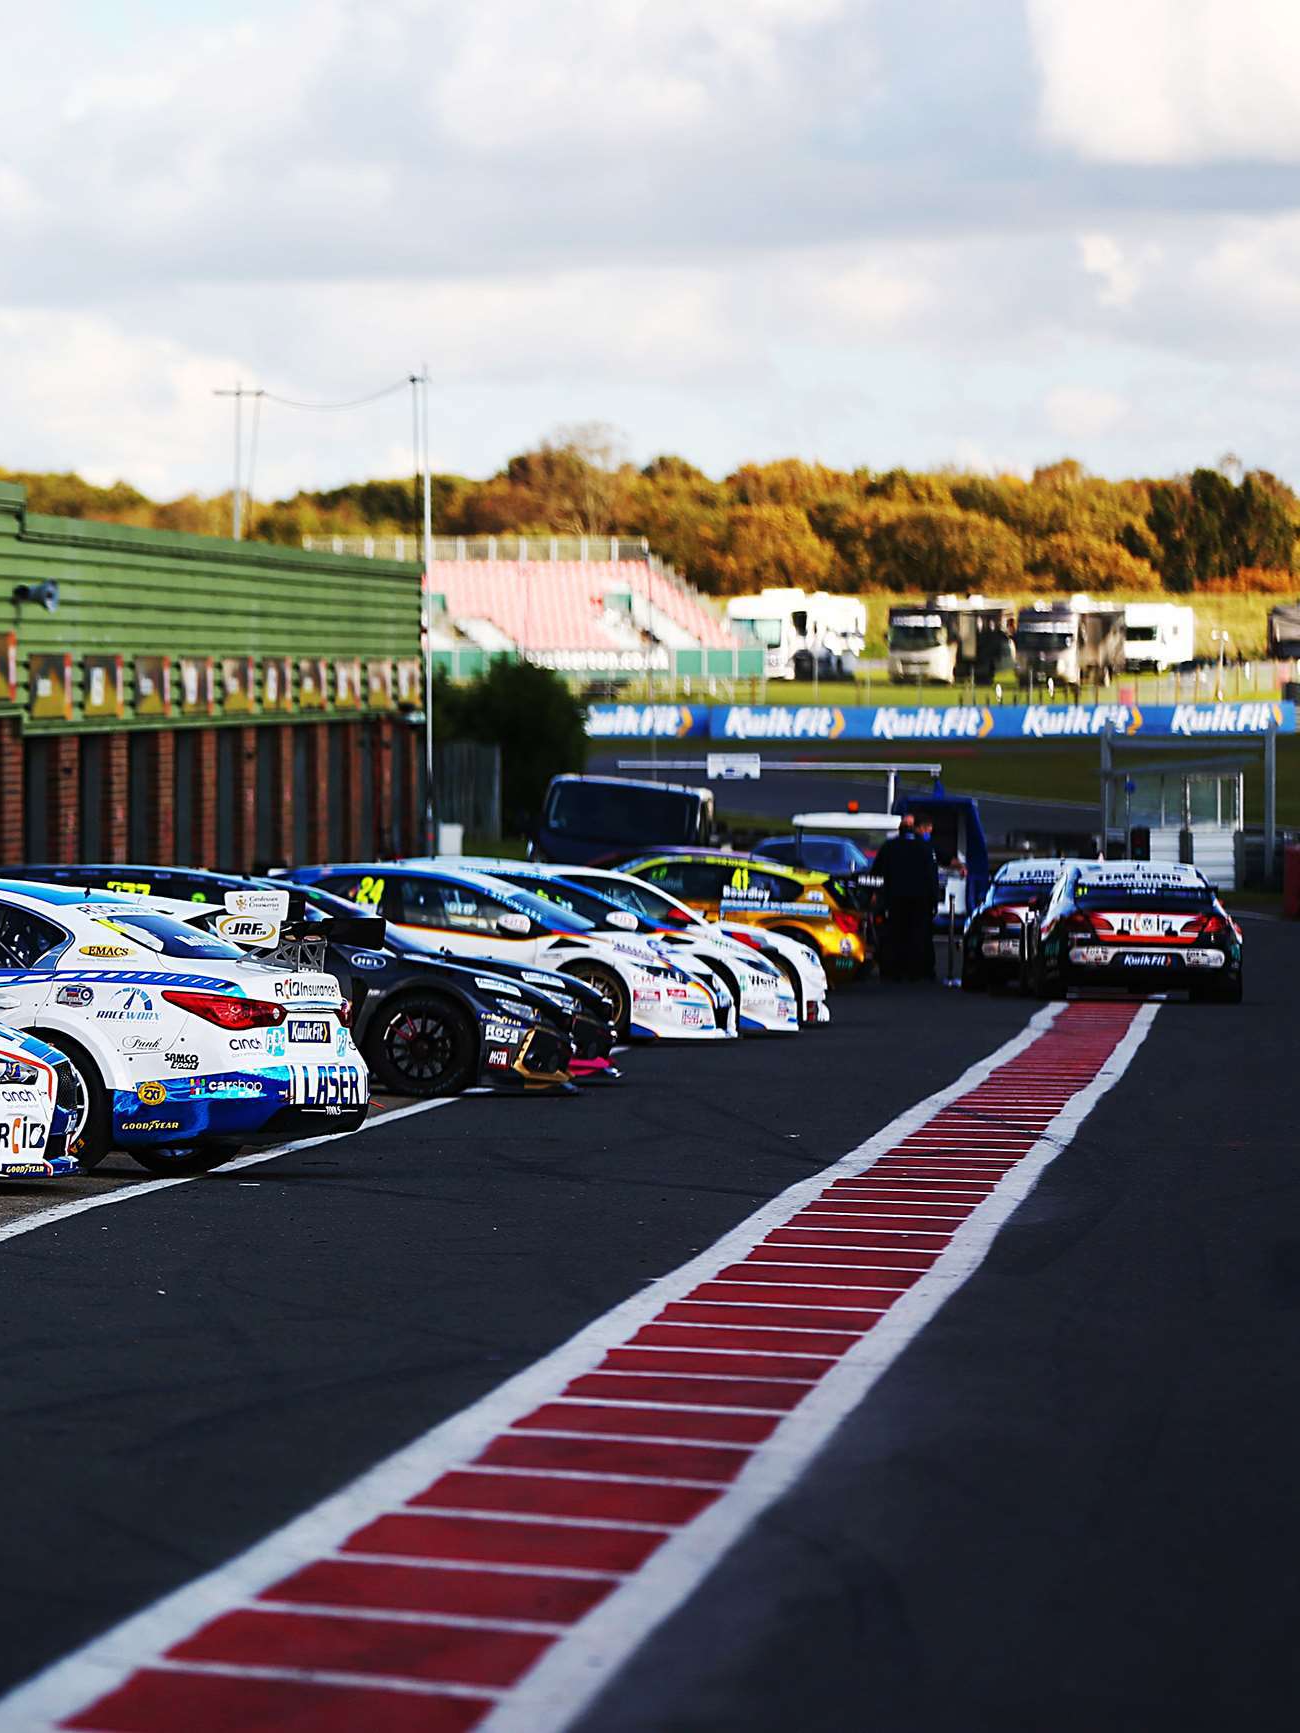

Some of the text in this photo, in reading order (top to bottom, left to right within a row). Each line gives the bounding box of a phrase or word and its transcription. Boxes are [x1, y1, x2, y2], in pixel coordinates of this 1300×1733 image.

[229, 923, 263, 935] JRF
[88, 946, 130, 957] EMACS
[164, 1053, 199, 1062] SAMCO
[208, 1079, 263, 1092] carshop
[302, 1066, 360, 1104] LASER
[2, 1089, 37, 1102] cinch
[122, 1120, 180, 1131] GOODYEAR
